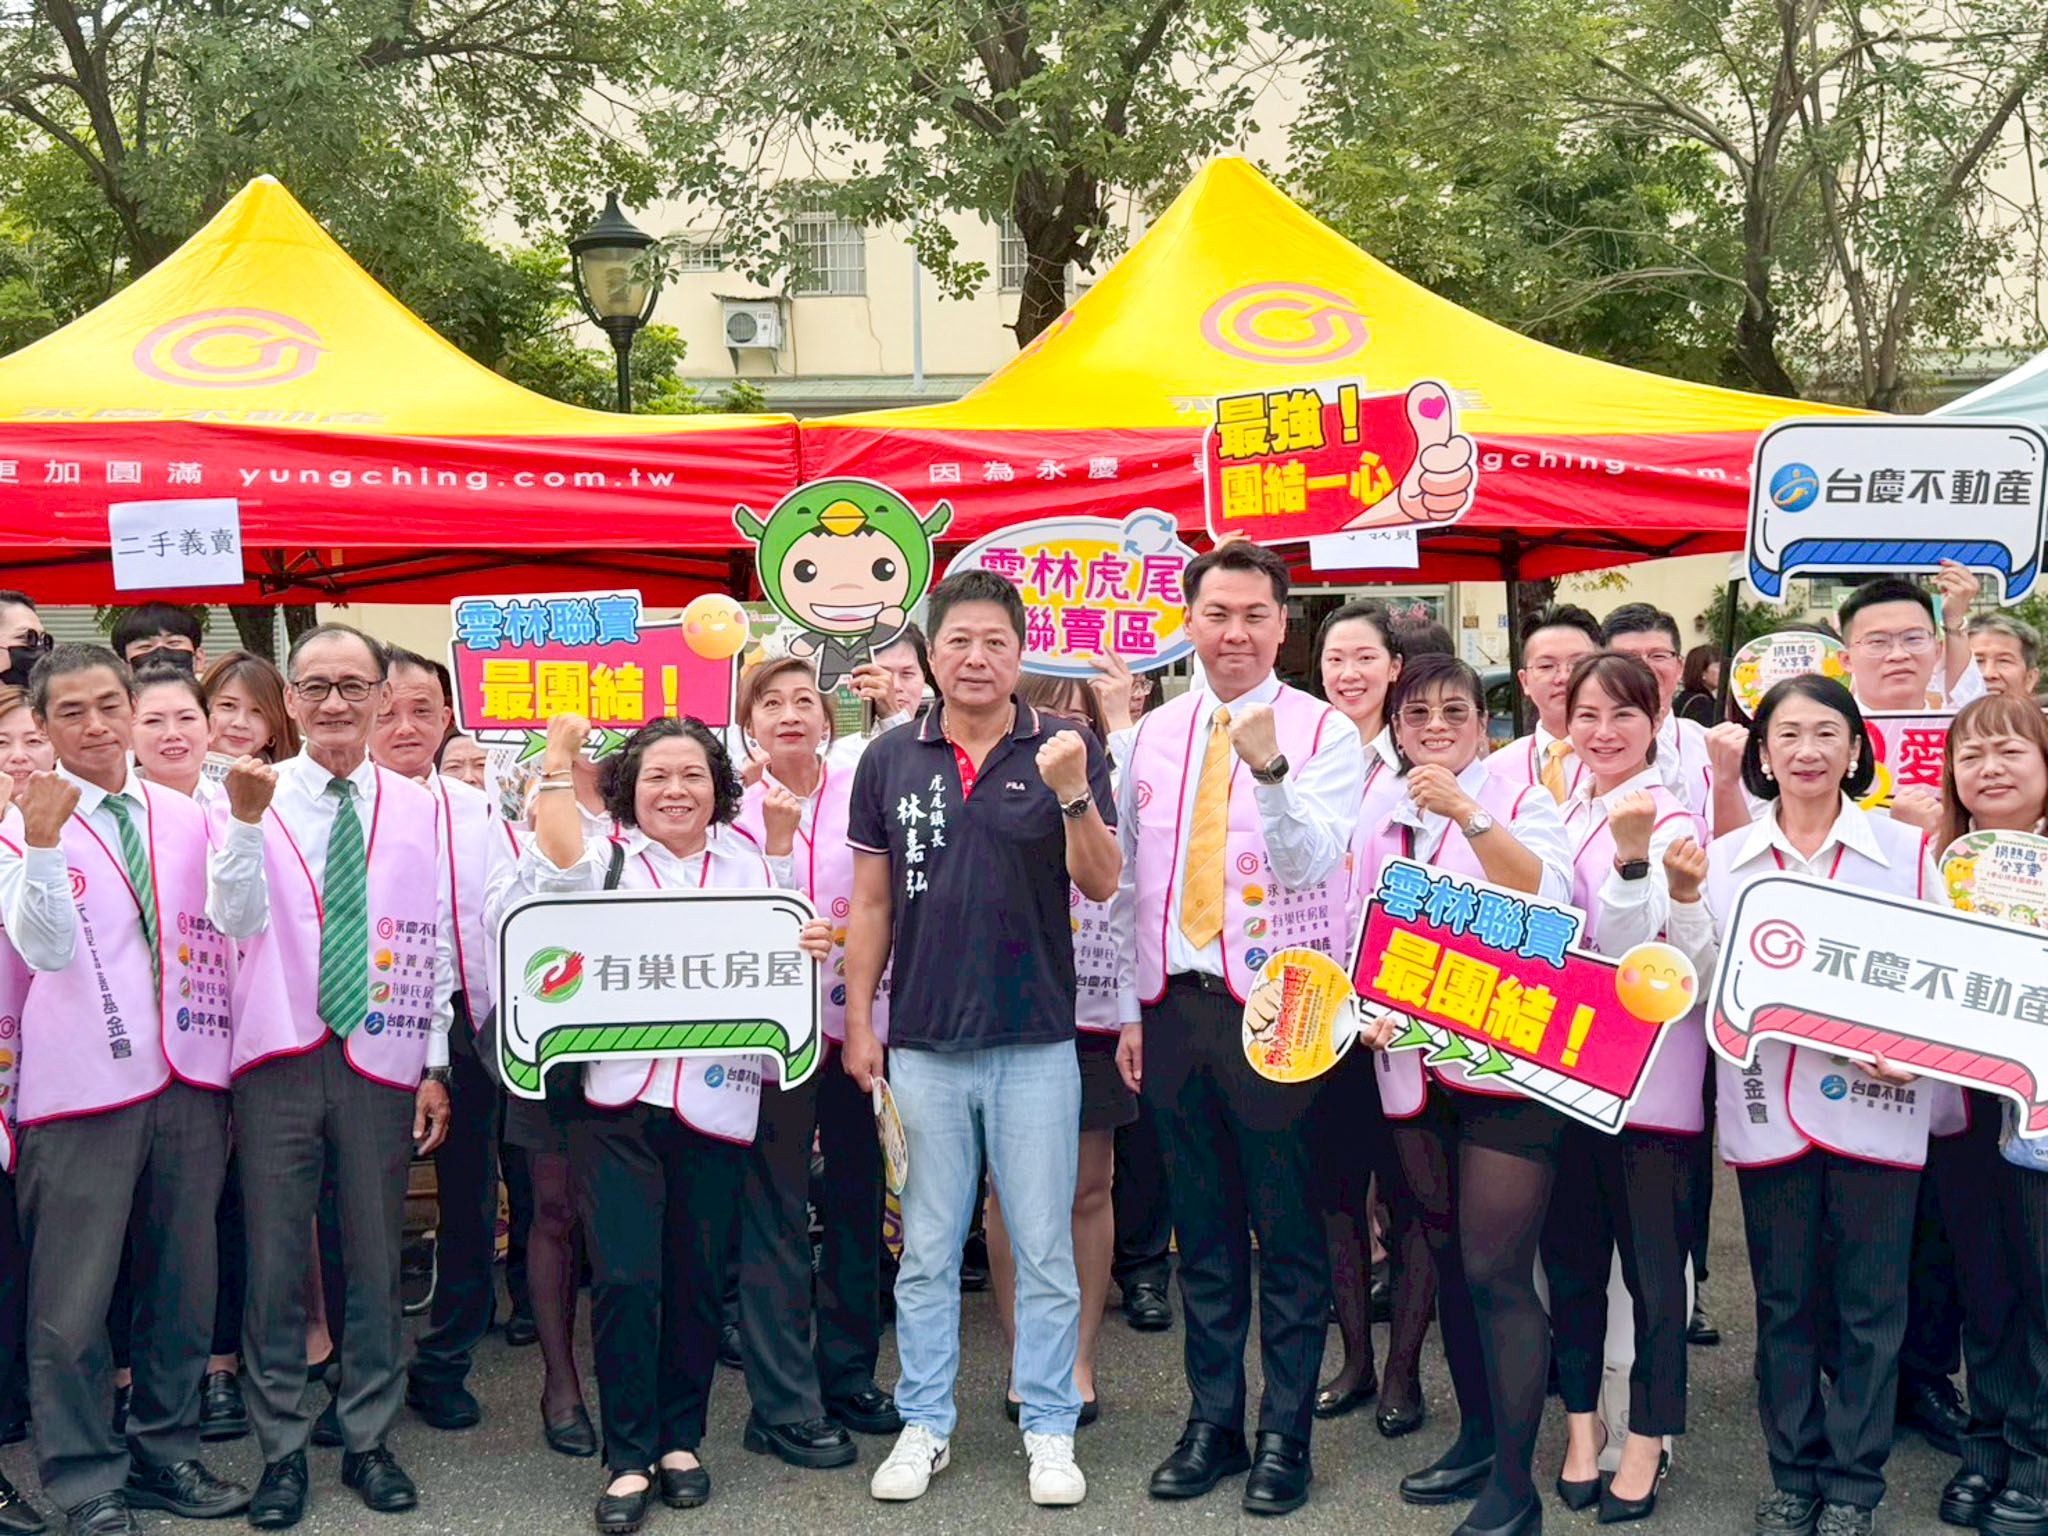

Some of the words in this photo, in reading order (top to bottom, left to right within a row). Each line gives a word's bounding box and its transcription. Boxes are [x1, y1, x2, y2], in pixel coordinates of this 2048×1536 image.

[239, 468, 675, 488] yungching.com.tw
[1221, 450, 1395, 519] 團結一心
[1824, 467, 2035, 506] 台慶不動產
[117, 527, 236, 558] 二手義賣
[980, 546, 1185, 604] 雲林虎尾
[456, 594, 641, 651] 雲林聯賣
[928, 774, 947, 848] 虎尾鎮長
[1005, 781, 1026, 791] FILA
[896, 792, 929, 900] 林嘉弘
[1378, 860, 1579, 969] 雲林聯賣
[593, 949, 805, 992] 有巢氏房屋
[1811, 937, 2048, 1027] 永慶不動產
